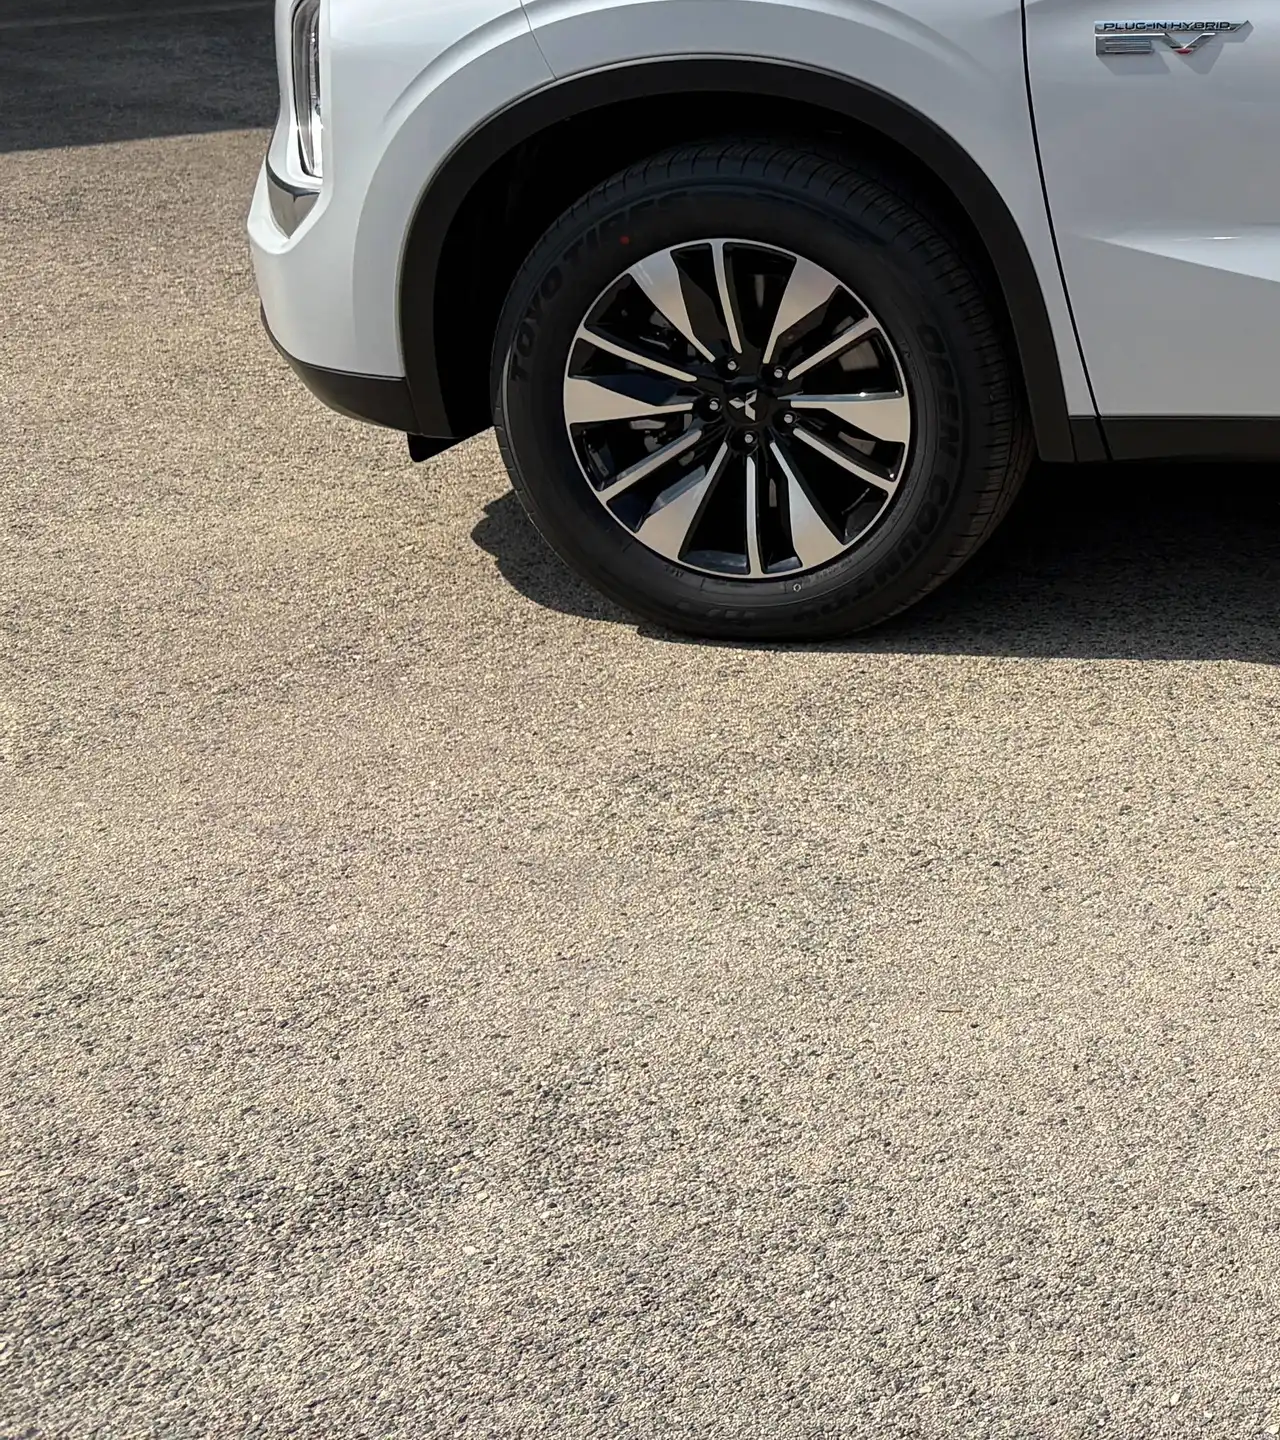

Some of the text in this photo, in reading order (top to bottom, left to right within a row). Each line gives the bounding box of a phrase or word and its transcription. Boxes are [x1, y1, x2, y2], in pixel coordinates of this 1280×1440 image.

[1103, 21, 1231, 31] PLUG-IN HYBRID
[1095, 32, 1216, 56] EV
